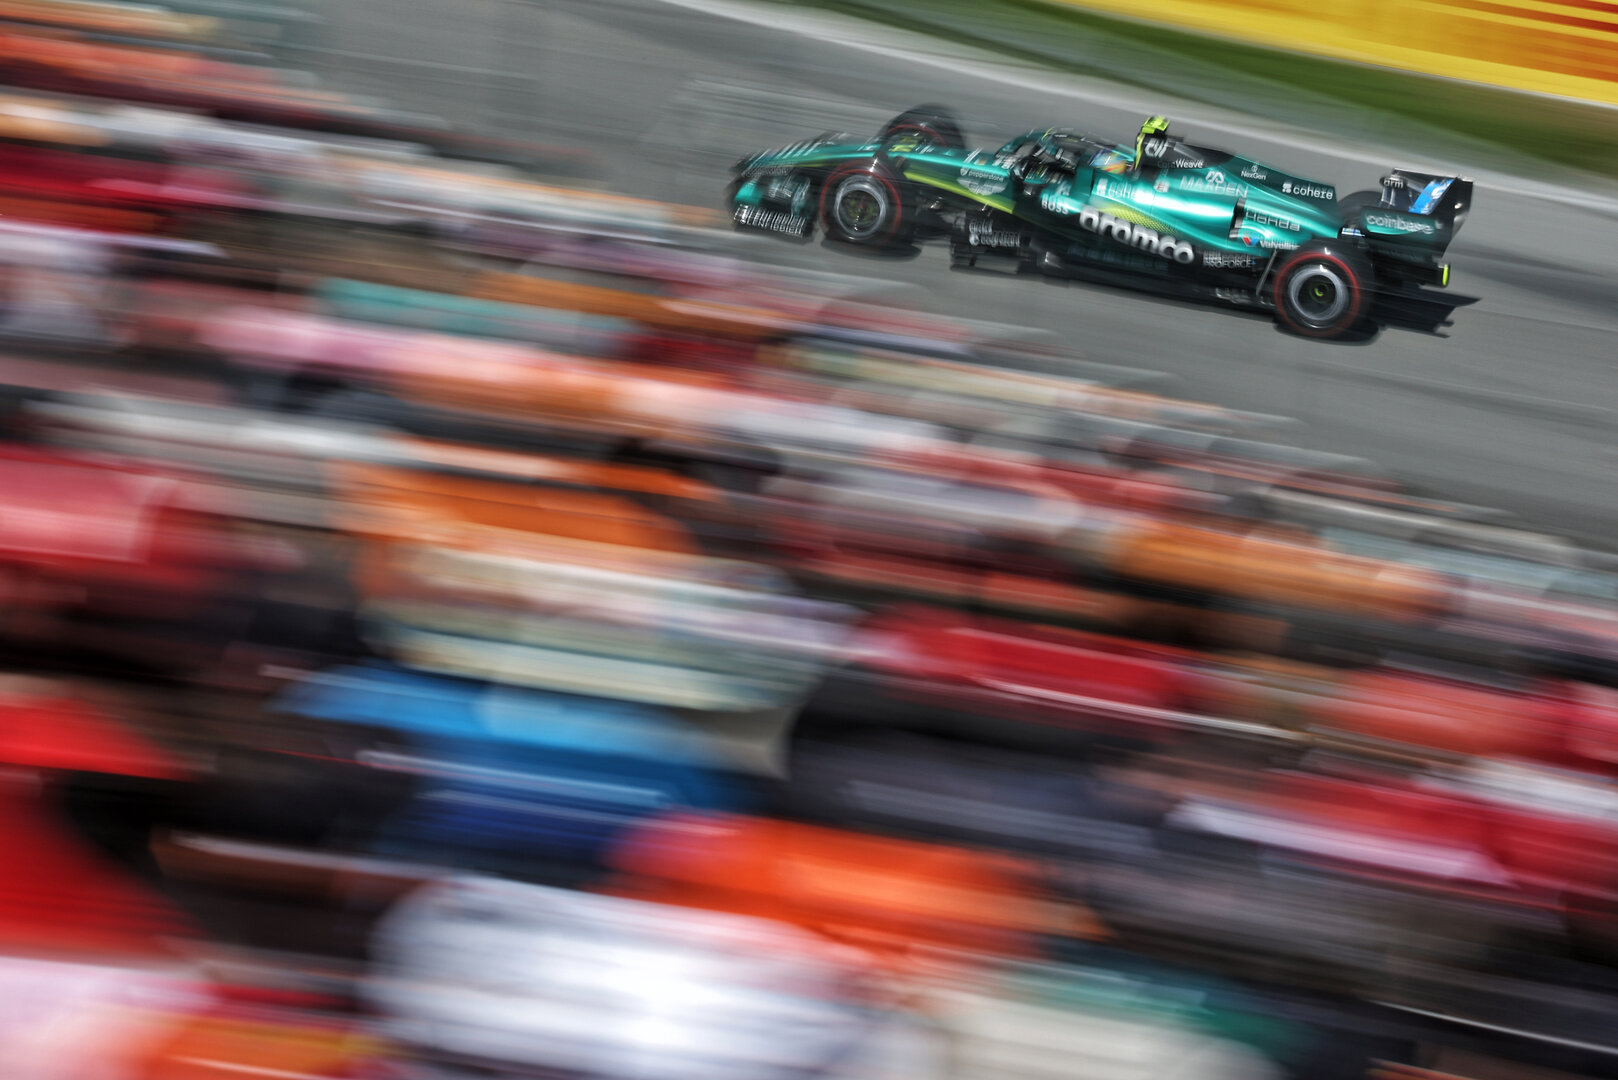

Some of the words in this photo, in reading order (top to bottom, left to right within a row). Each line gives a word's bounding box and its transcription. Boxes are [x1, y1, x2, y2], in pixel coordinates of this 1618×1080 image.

[1240, 169, 1267, 181] NexGen
[1383, 177, 1404, 189] arm
[1292, 183, 1334, 200] cohere
[1041, 193, 1070, 215] BOSS
[1365, 213, 1435, 235] coinbase
[1079, 204, 1195, 264] aramco
